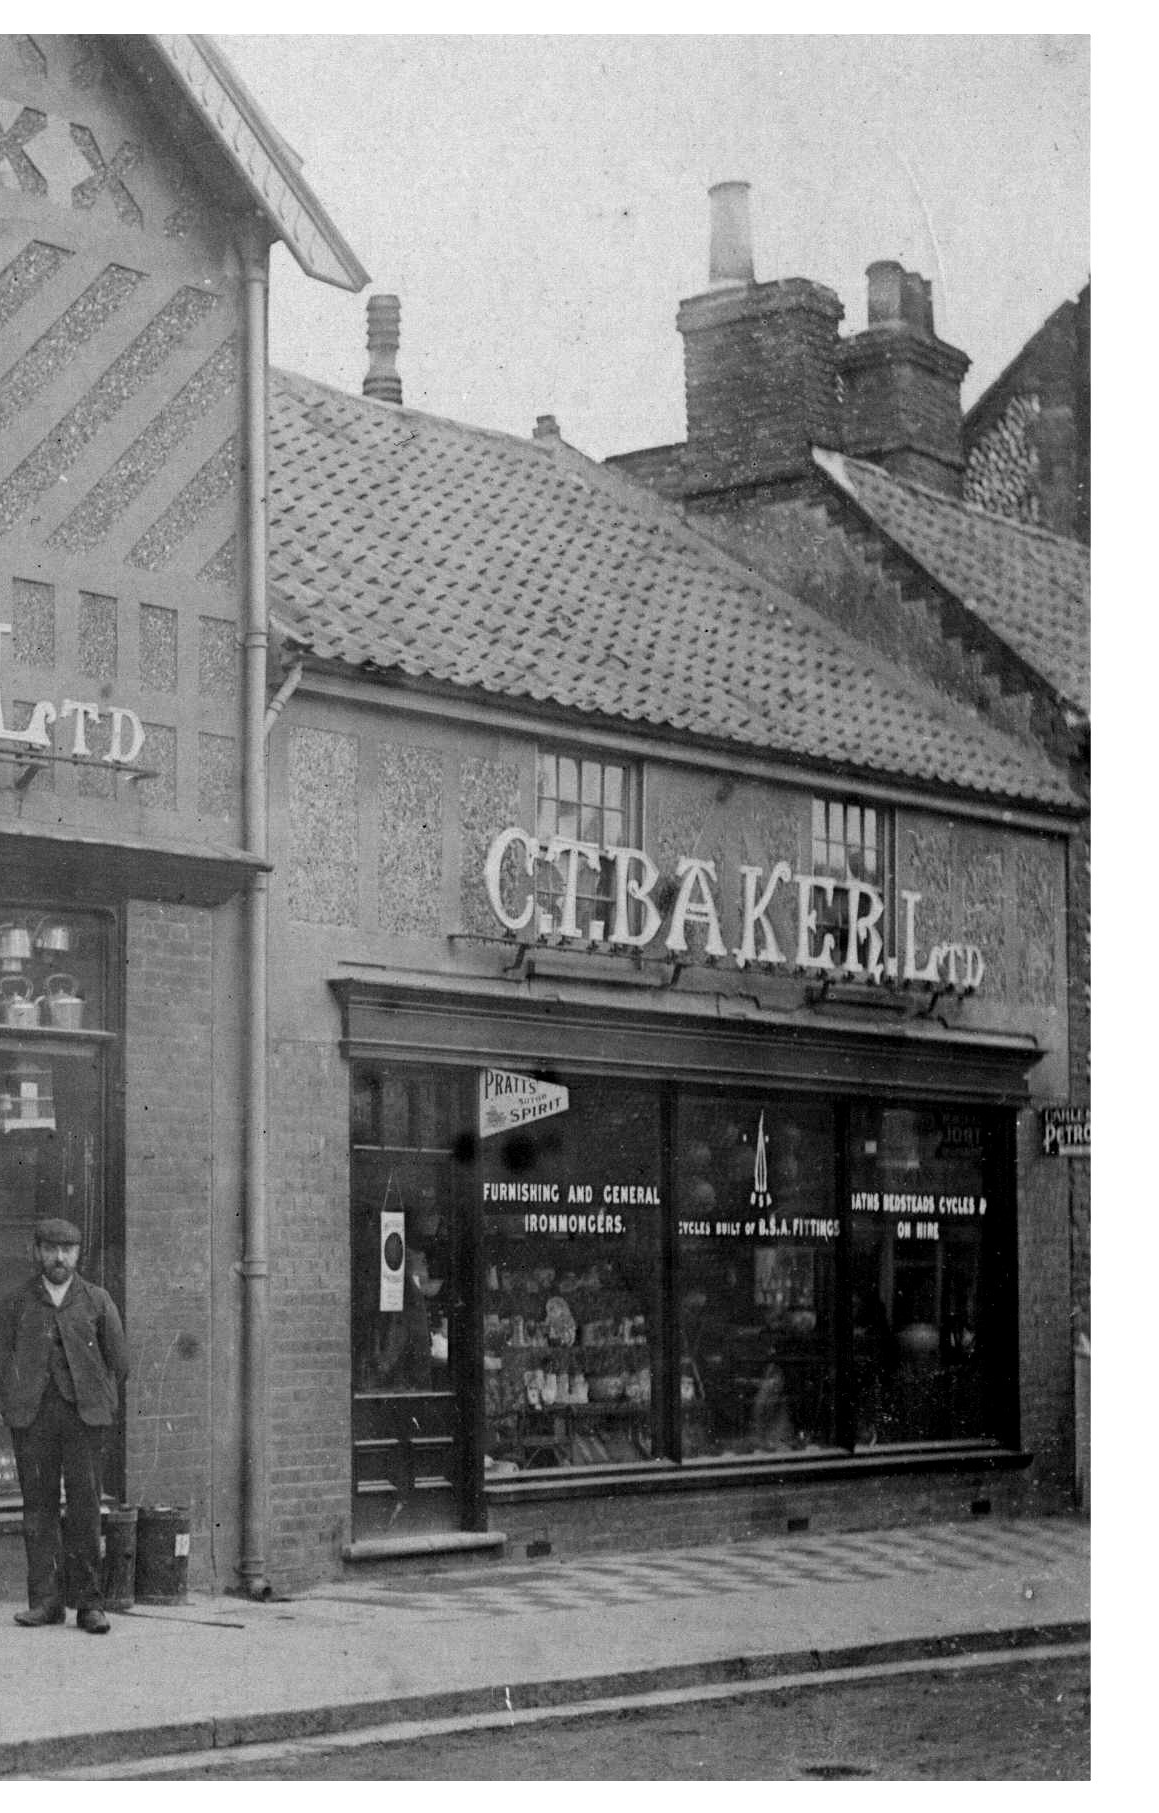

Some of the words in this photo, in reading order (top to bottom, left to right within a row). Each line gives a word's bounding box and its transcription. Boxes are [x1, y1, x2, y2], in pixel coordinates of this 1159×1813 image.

[510, 1096, 563, 1123] SPIRIT
[483, 1183, 560, 1203] FURNISHING
[567, 1184, 593, 1204] AND
[603, 1185, 661, 1205] GENERAL
[883, 1193, 935, 1214] BEDSTEADS
[939, 1195, 975, 1215] CYCLES
[524, 1213, 626, 1234] IRONMONGERS.
[715, 1221, 741, 1236] BUILT
[793, 1217, 840, 1238] FITTINGS
[897, 1221, 911, 1239] ON
[916, 1221, 939, 1240] HIRE
